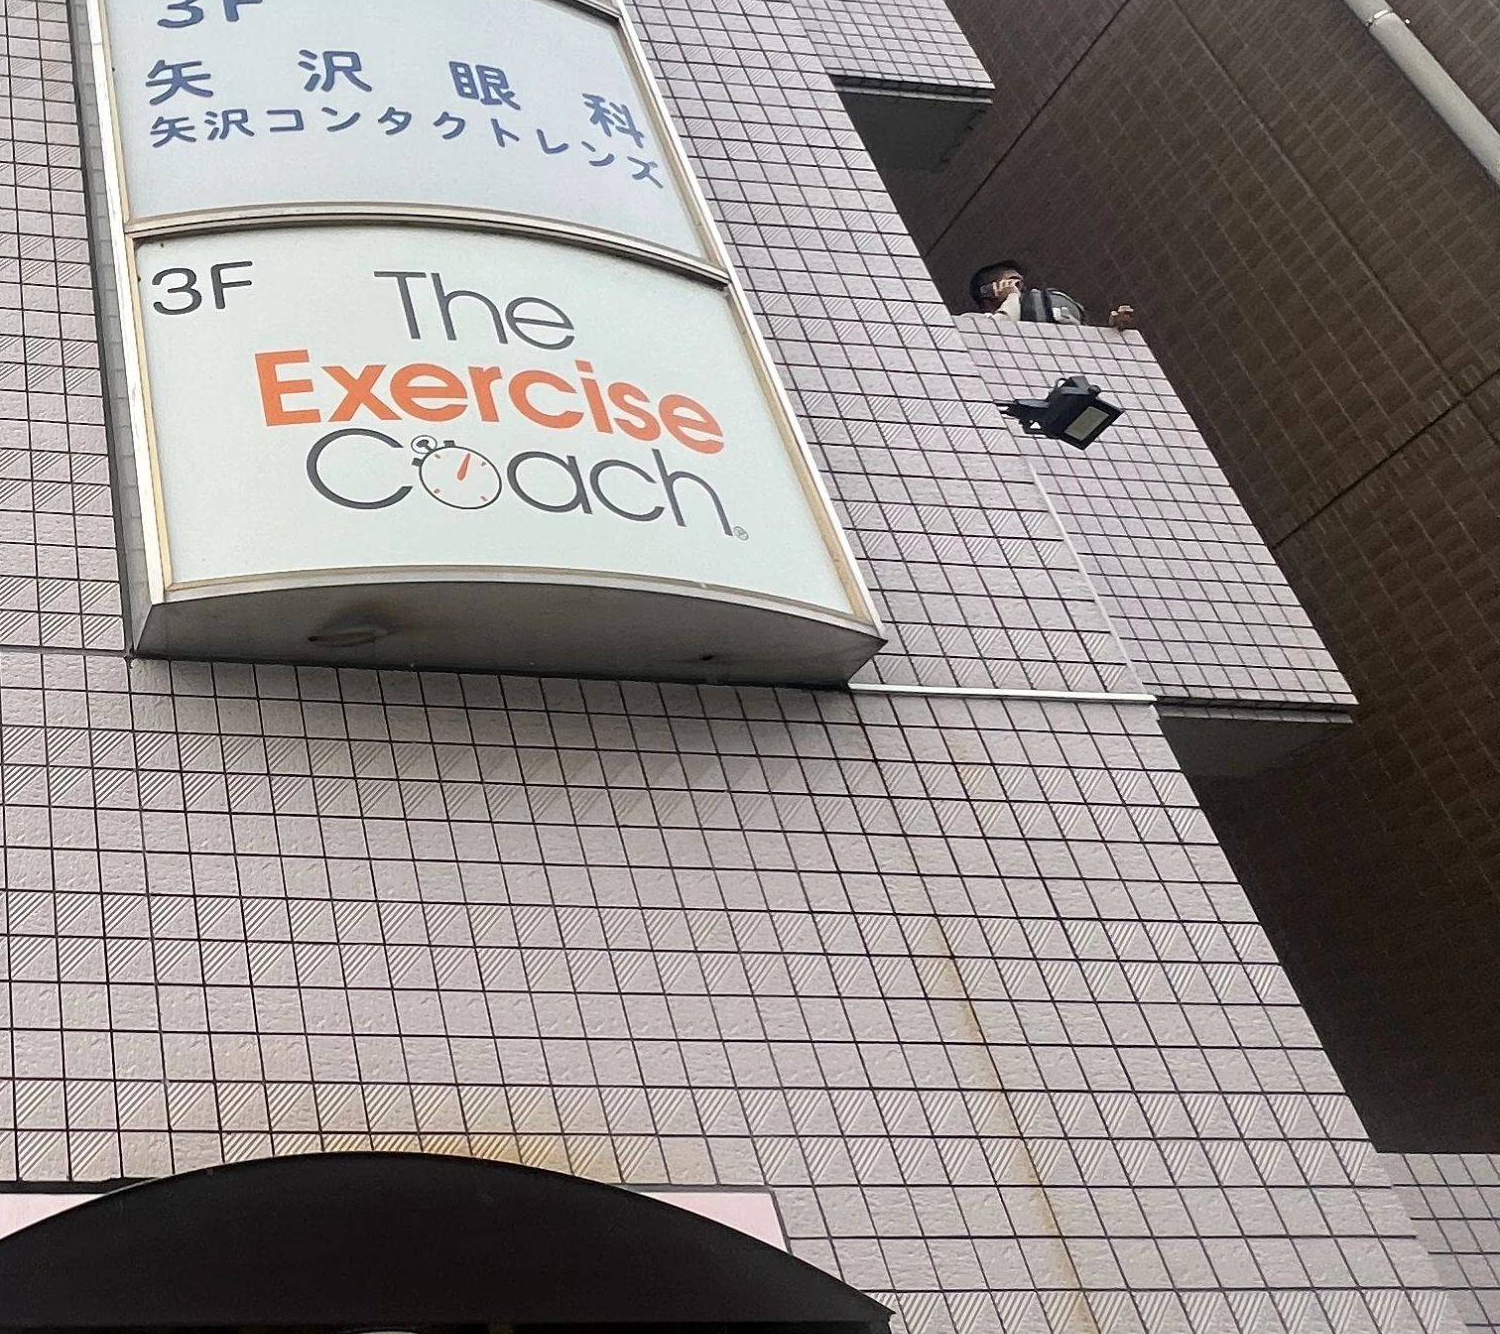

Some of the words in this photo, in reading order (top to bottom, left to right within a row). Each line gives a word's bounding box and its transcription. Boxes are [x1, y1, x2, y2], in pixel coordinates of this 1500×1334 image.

[145, 49, 645, 147] 矢沢眼科
[150, 105, 665, 191] 矢沢コンタクトレンズ
[152, 261, 253, 316] 3F
[374, 270, 574, 350] The
[255, 349, 725, 455] Exercise
[306, 428, 732, 538] Coach
